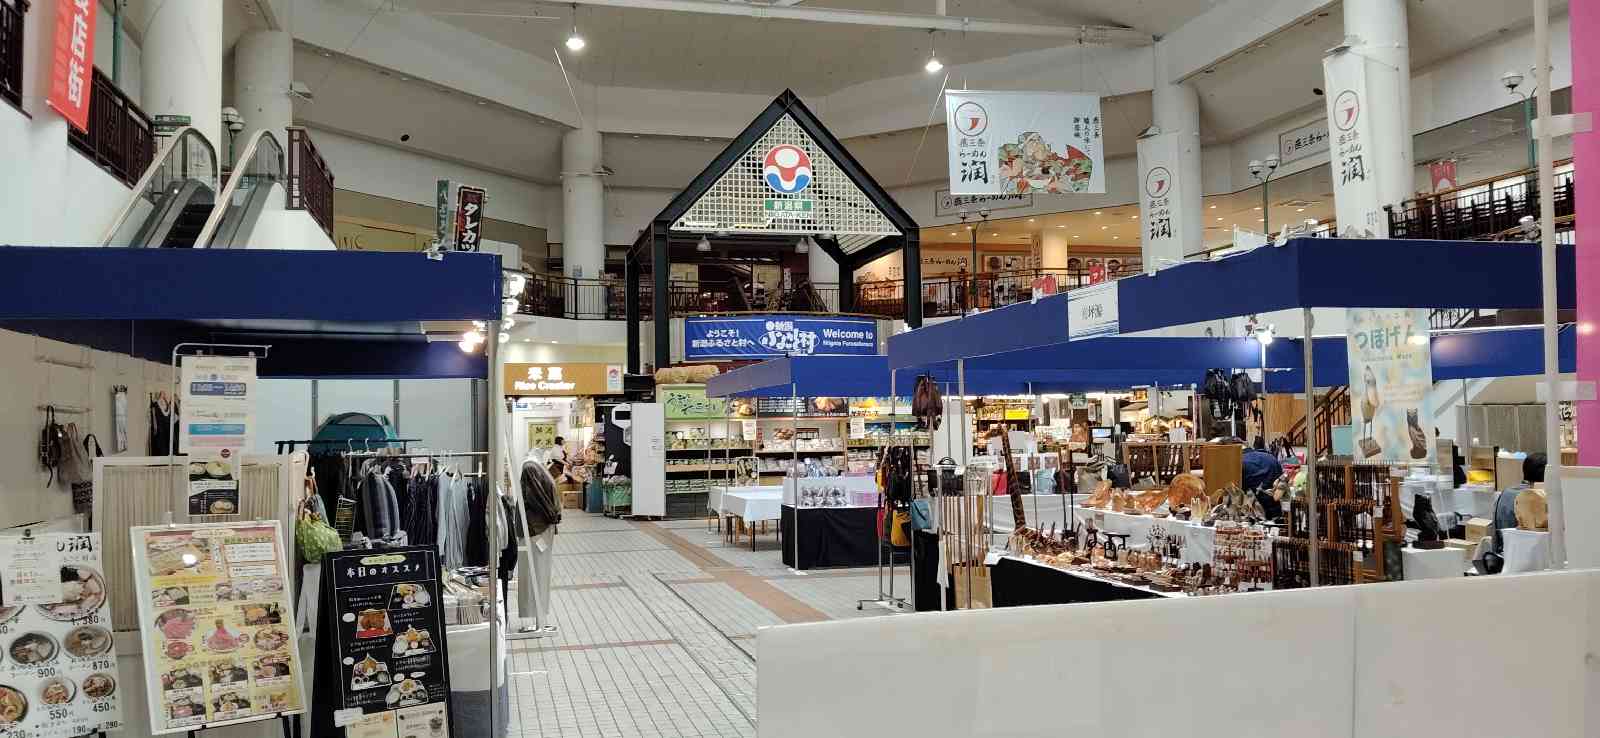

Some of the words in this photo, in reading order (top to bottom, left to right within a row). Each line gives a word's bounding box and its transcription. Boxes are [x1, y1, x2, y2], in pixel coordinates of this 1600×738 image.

[960, 149, 988, 158] らーめん
[960, 160, 989, 184] 潤
[1341, 154, 1365, 187] 潤
[1150, 217, 1171, 240] 潤
[823, 328, 864, 339] Welcome
[865, 330, 874, 339] to
[514, 380, 537, 391] Rice
